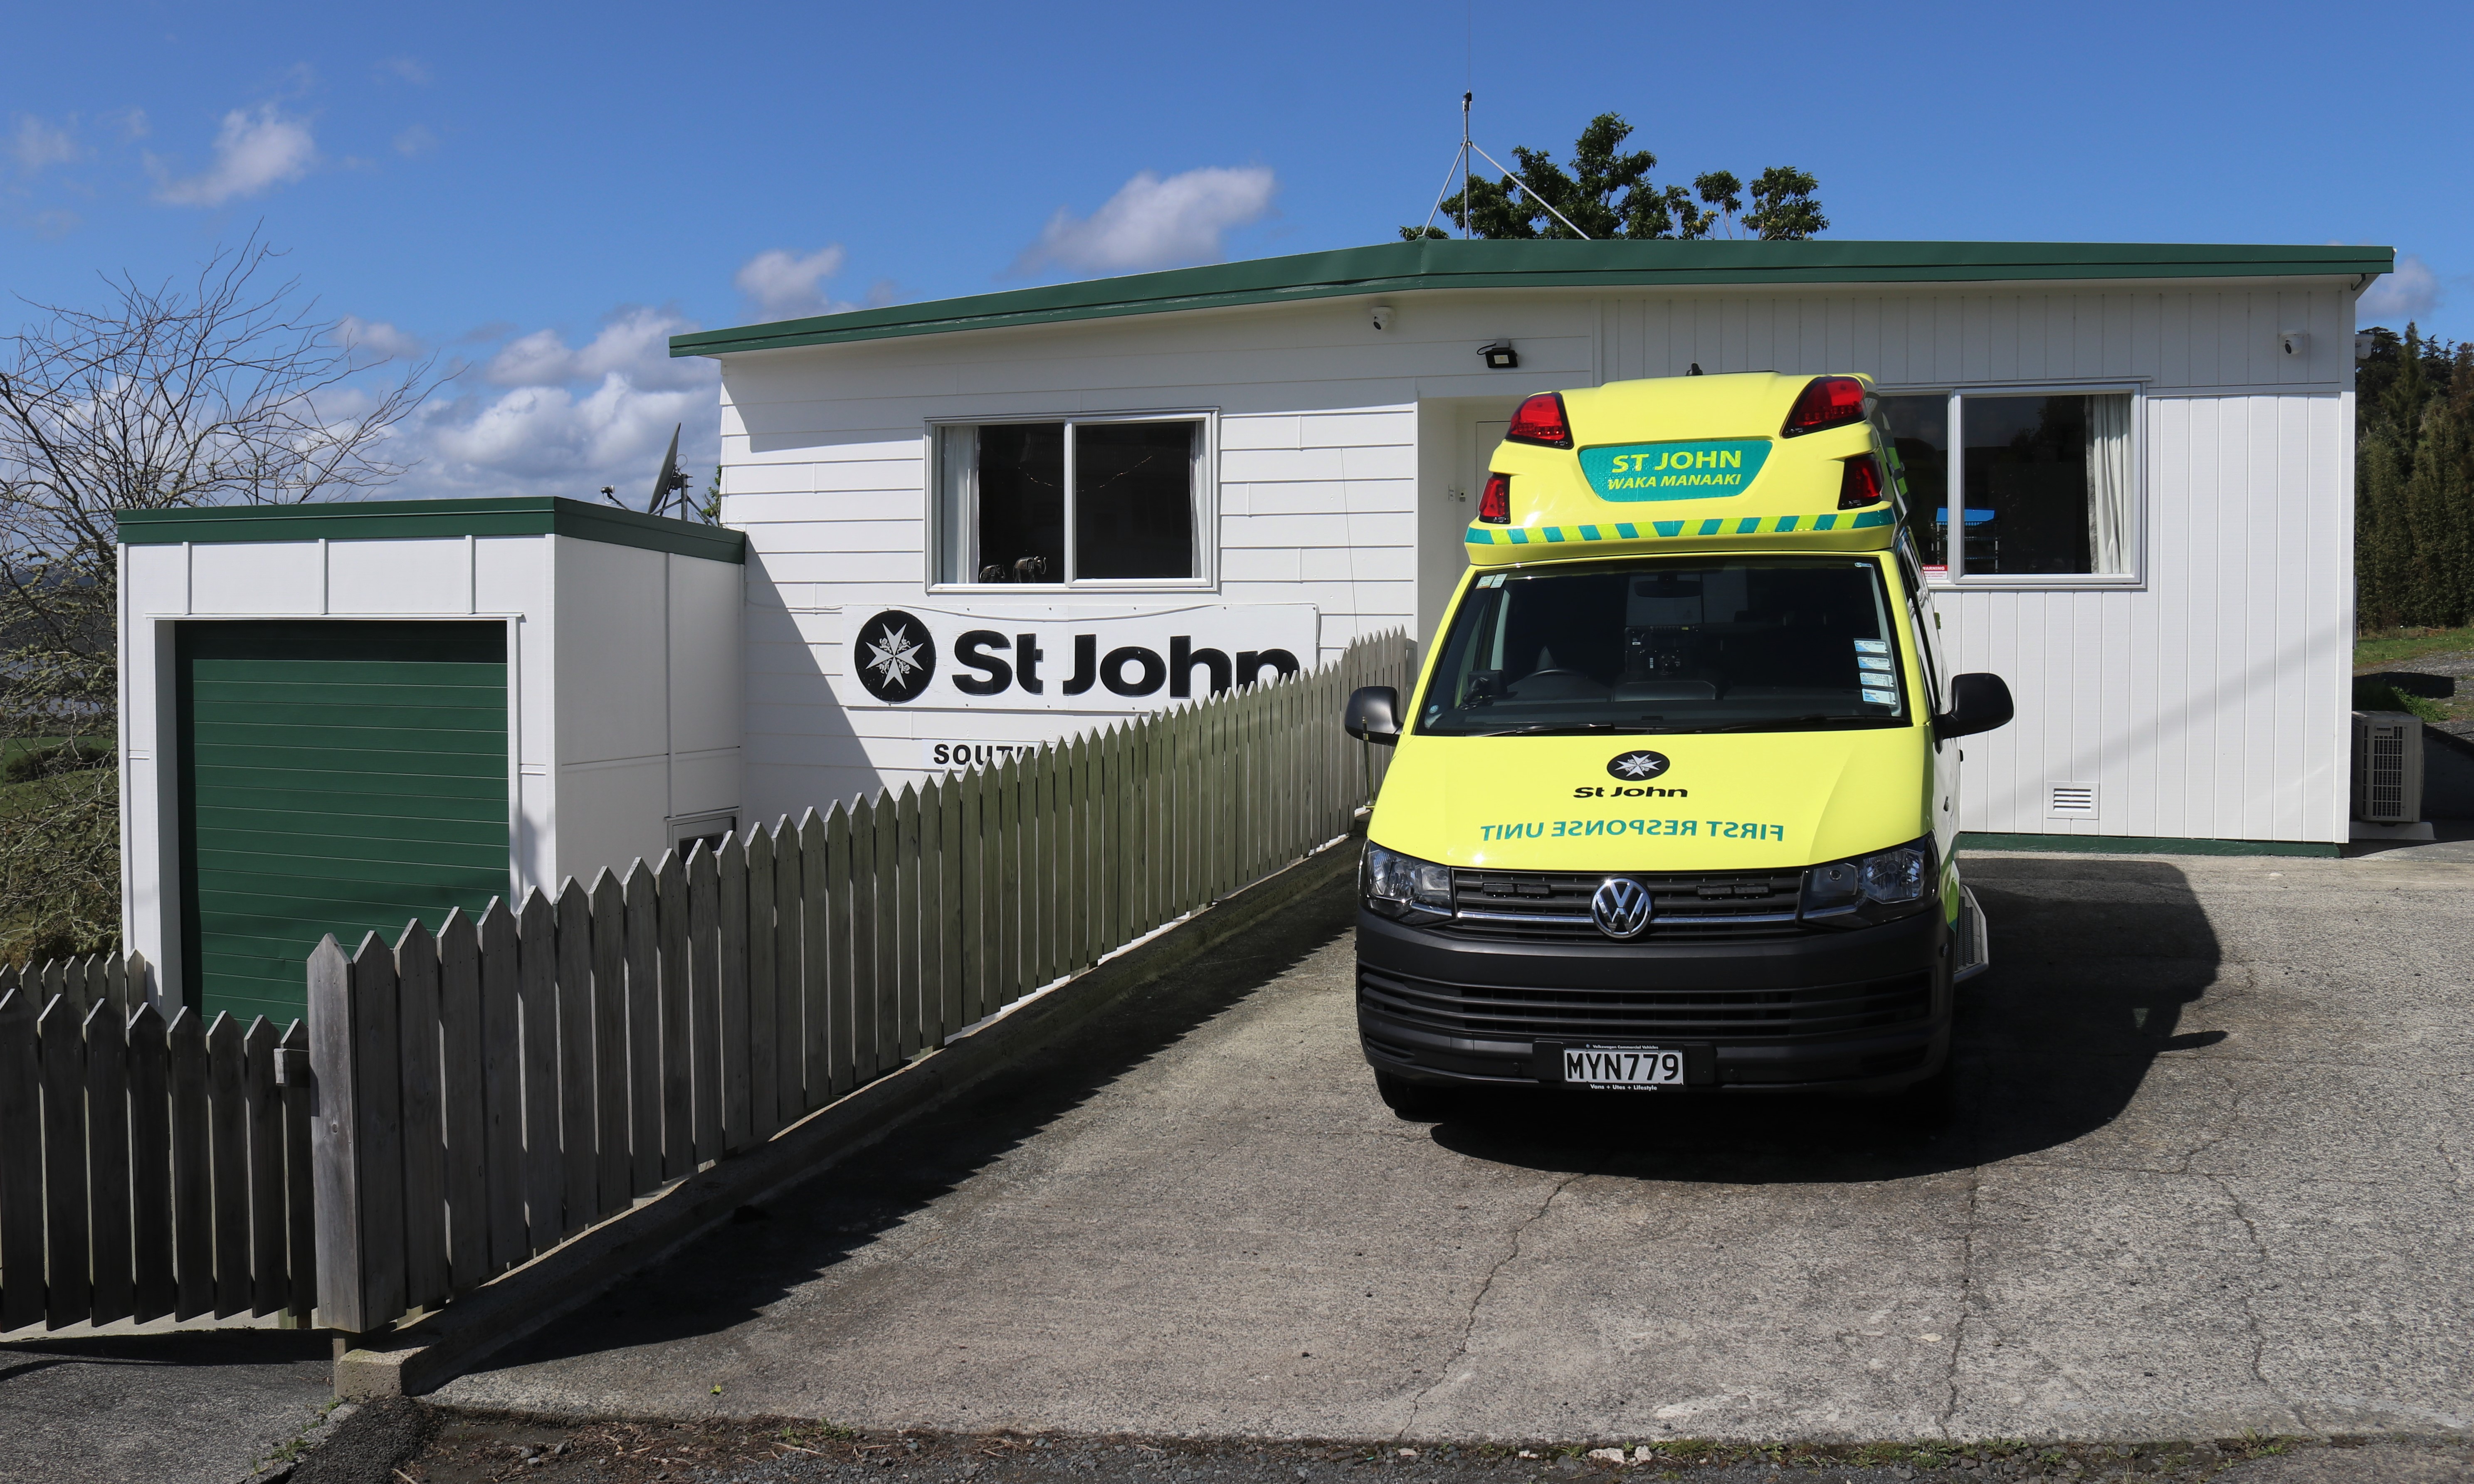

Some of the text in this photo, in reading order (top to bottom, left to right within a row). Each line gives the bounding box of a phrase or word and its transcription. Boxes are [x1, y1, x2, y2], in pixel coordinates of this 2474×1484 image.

[1612, 450, 1741, 473] ST JOHN
[1608, 474, 1742, 490] WAKA MANAAKI
[952, 630, 1300, 698] St John
[1573, 786, 1688, 798] St John
[1566, 1052, 1679, 1081] MYN779
